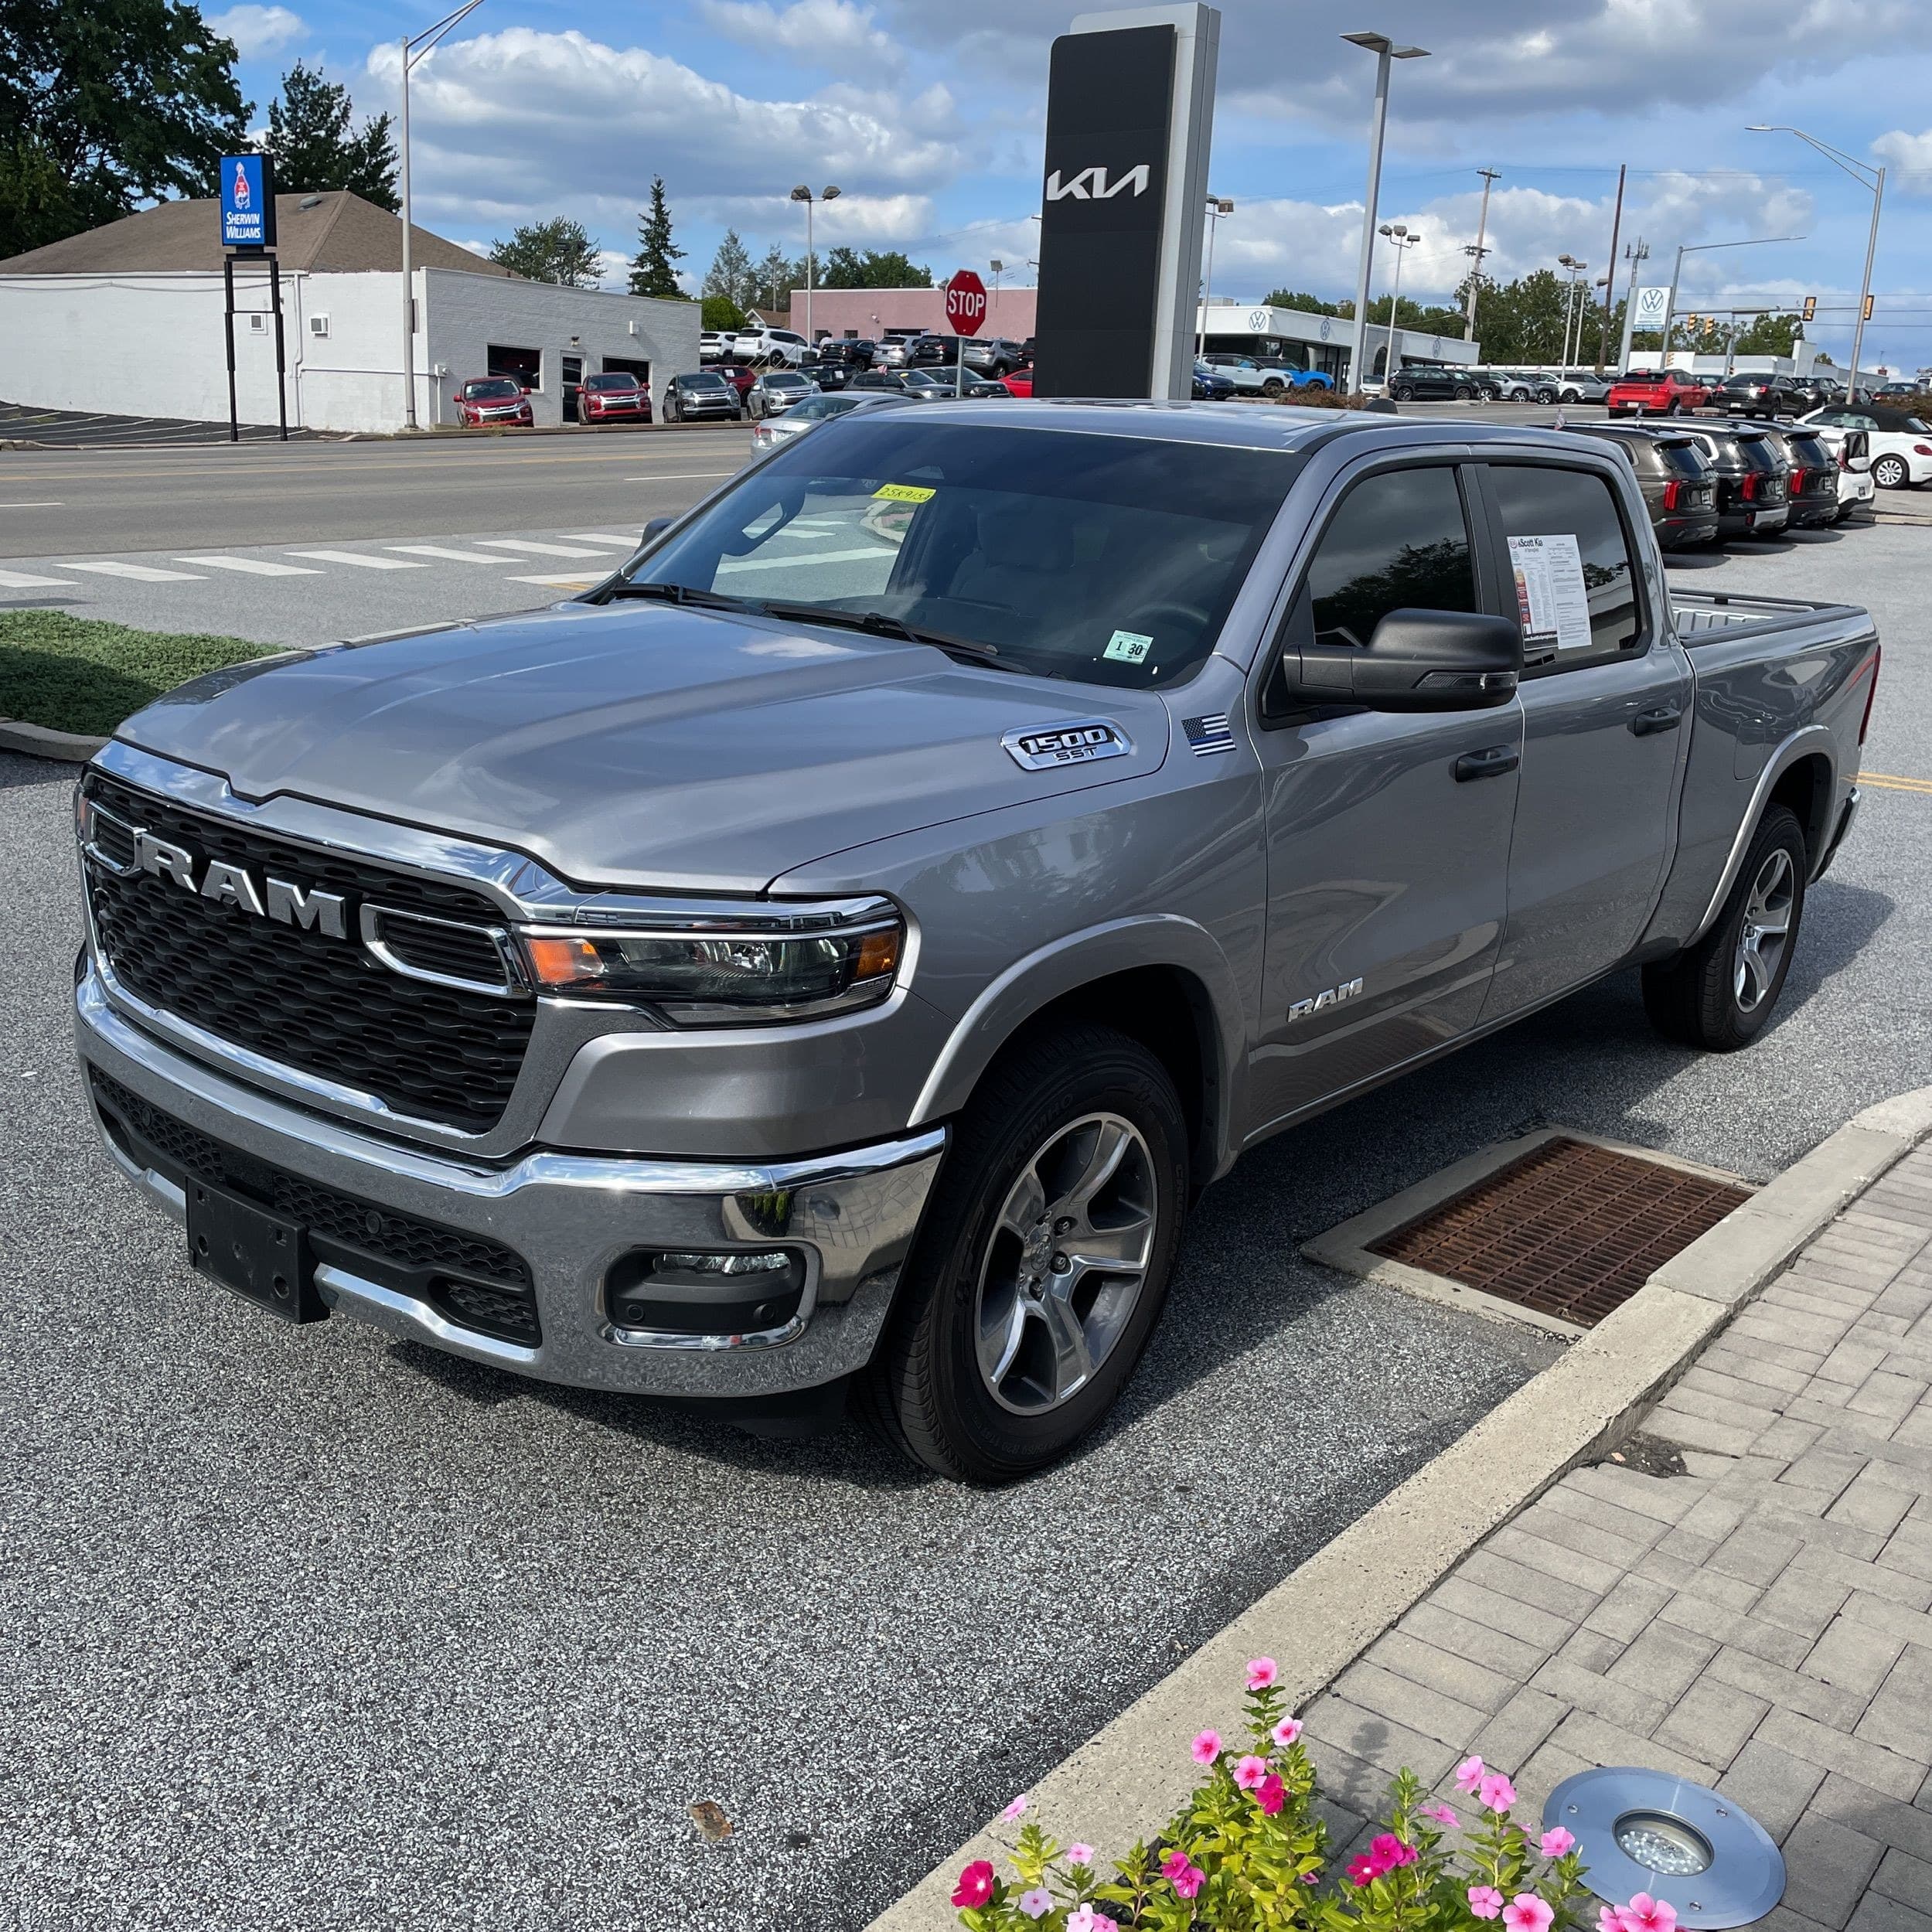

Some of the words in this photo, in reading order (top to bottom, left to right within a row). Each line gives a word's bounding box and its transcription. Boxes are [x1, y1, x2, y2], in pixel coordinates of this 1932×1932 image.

[1046, 164, 1150, 201] KIA
[227, 212, 260, 225] SHERWIN
[226, 226, 261, 239] WILLIAMS
[948, 289, 985, 317] STOP
[1116, 641, 1123, 651] 1
[1128, 643, 1143, 656] 30
[1022, 728, 1109, 755] 1500
[1053, 746, 1097, 762] SST
[141, 832, 347, 939] RAM
[1287, 977, 1363, 1022] RAM
